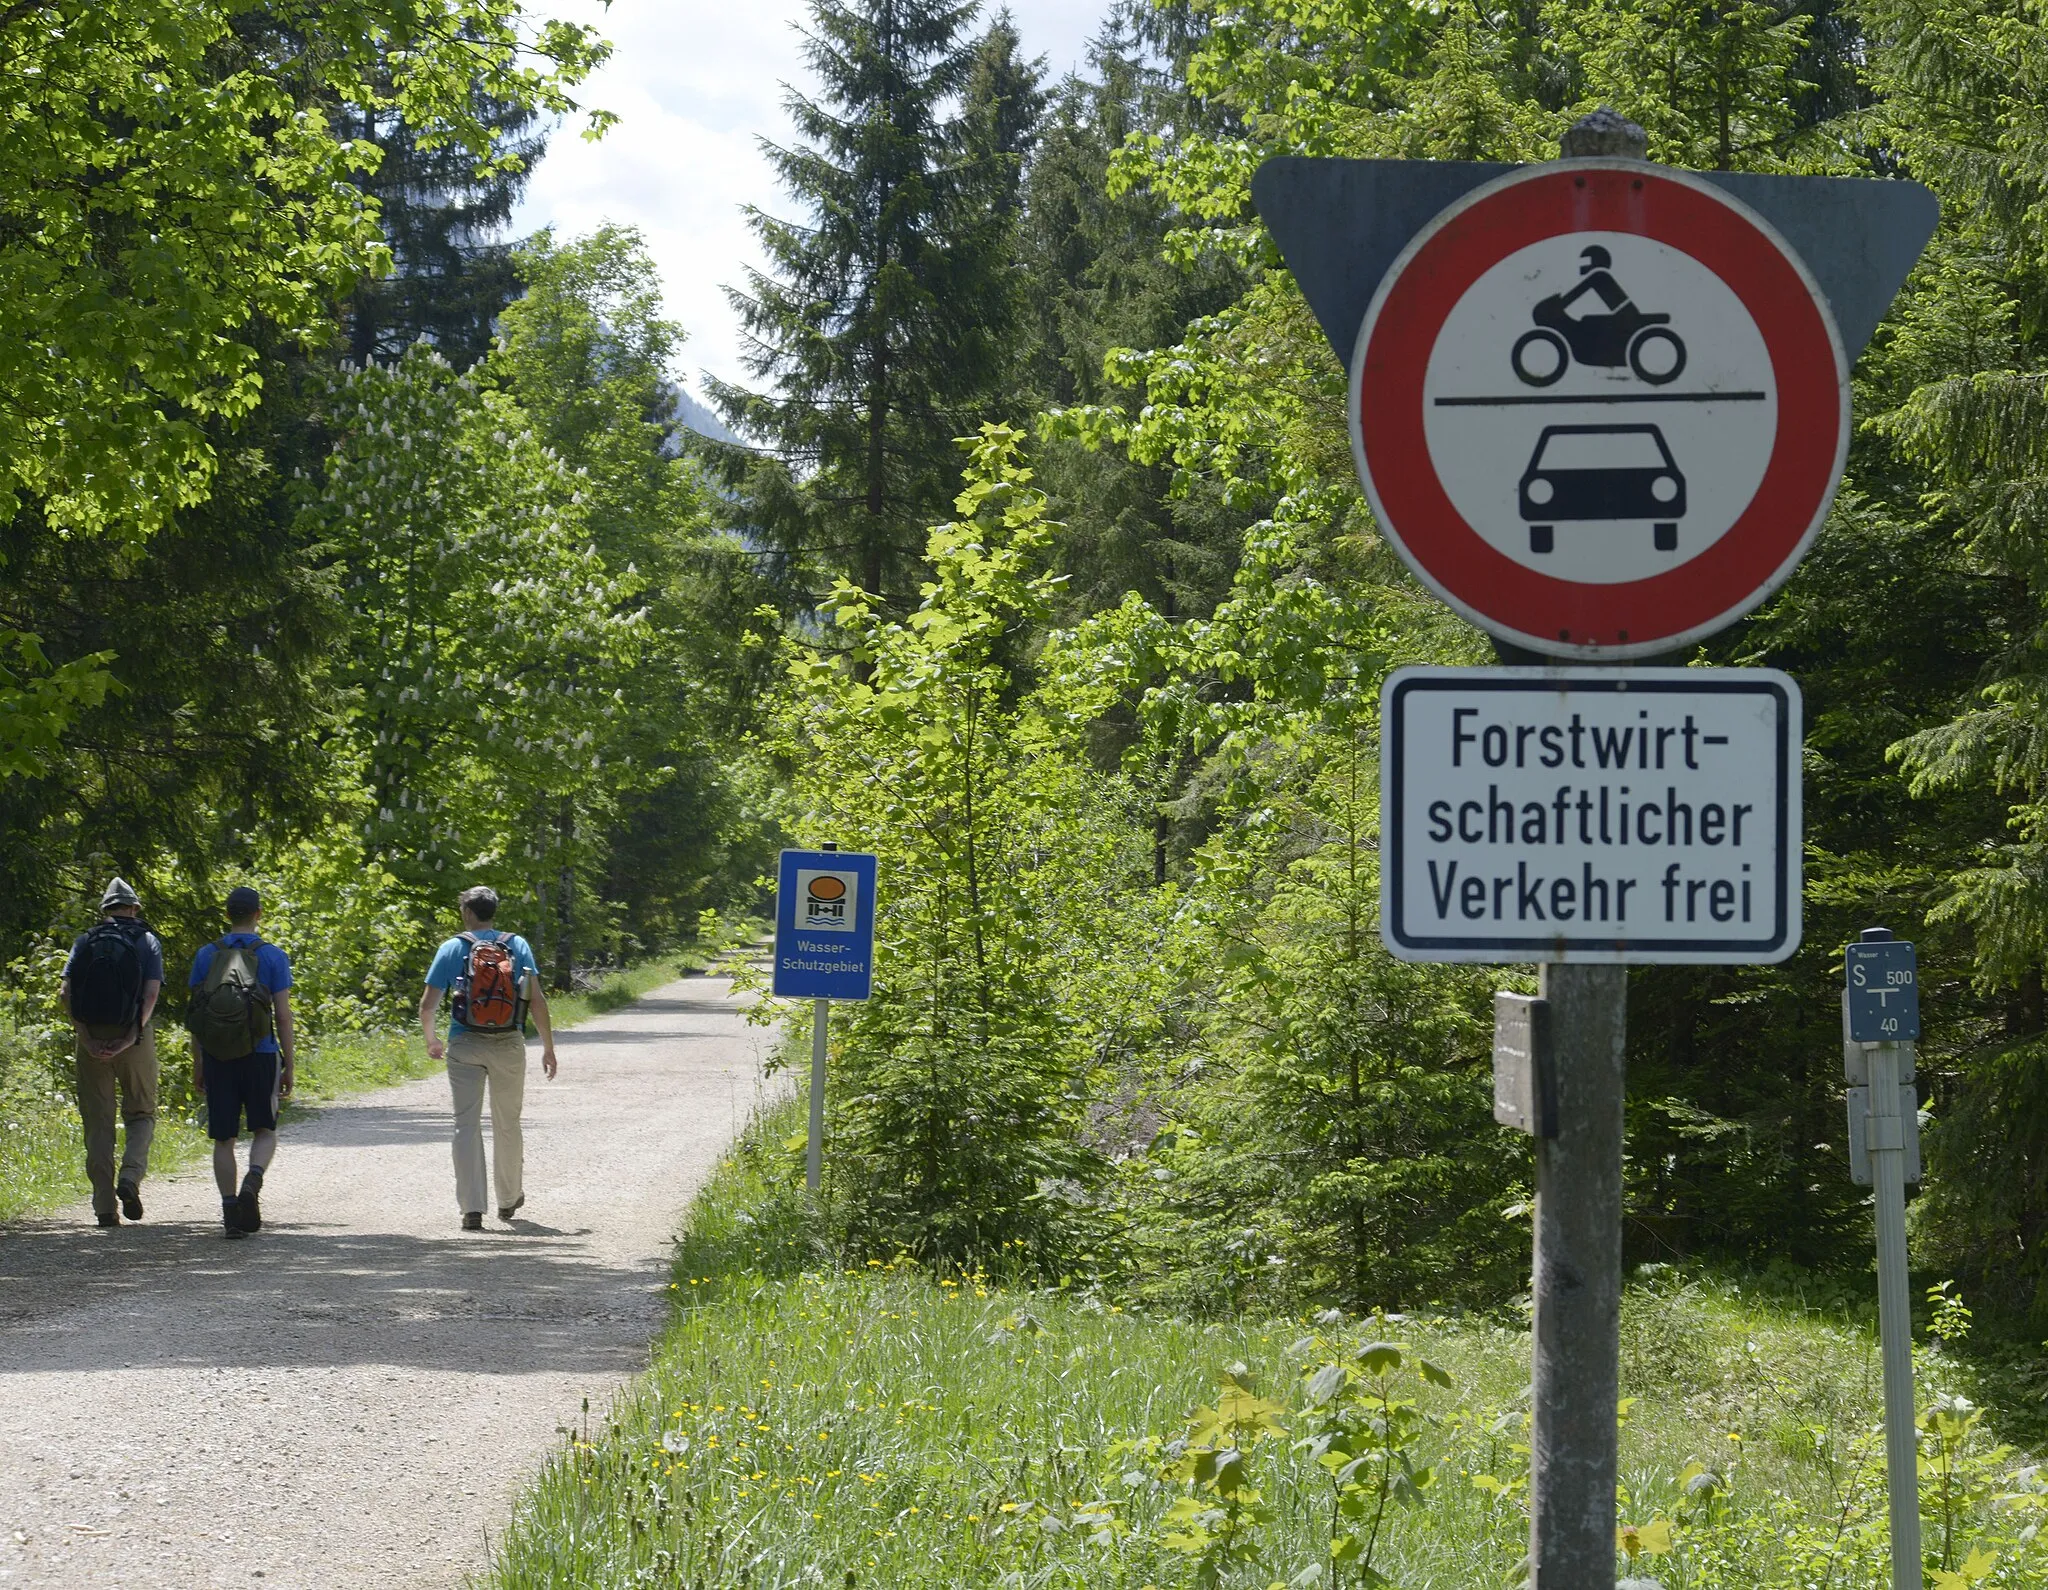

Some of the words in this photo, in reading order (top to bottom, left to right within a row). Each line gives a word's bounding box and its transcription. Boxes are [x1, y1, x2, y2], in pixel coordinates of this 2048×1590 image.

[1452, 708, 1729, 770] Forstwirt-
[1428, 784, 1753, 847] schaftlicher
[1427, 860, 1637, 922] Verkehr
[1661, 862, 1752, 923] frei
[797, 940, 851, 954] Wasser-
[782, 958, 864, 974] Schutzgebiet
[1853, 964, 1867, 987] S
[1886, 970, 1913, 985] 500
[1880, 1017, 1899, 1032] 40
